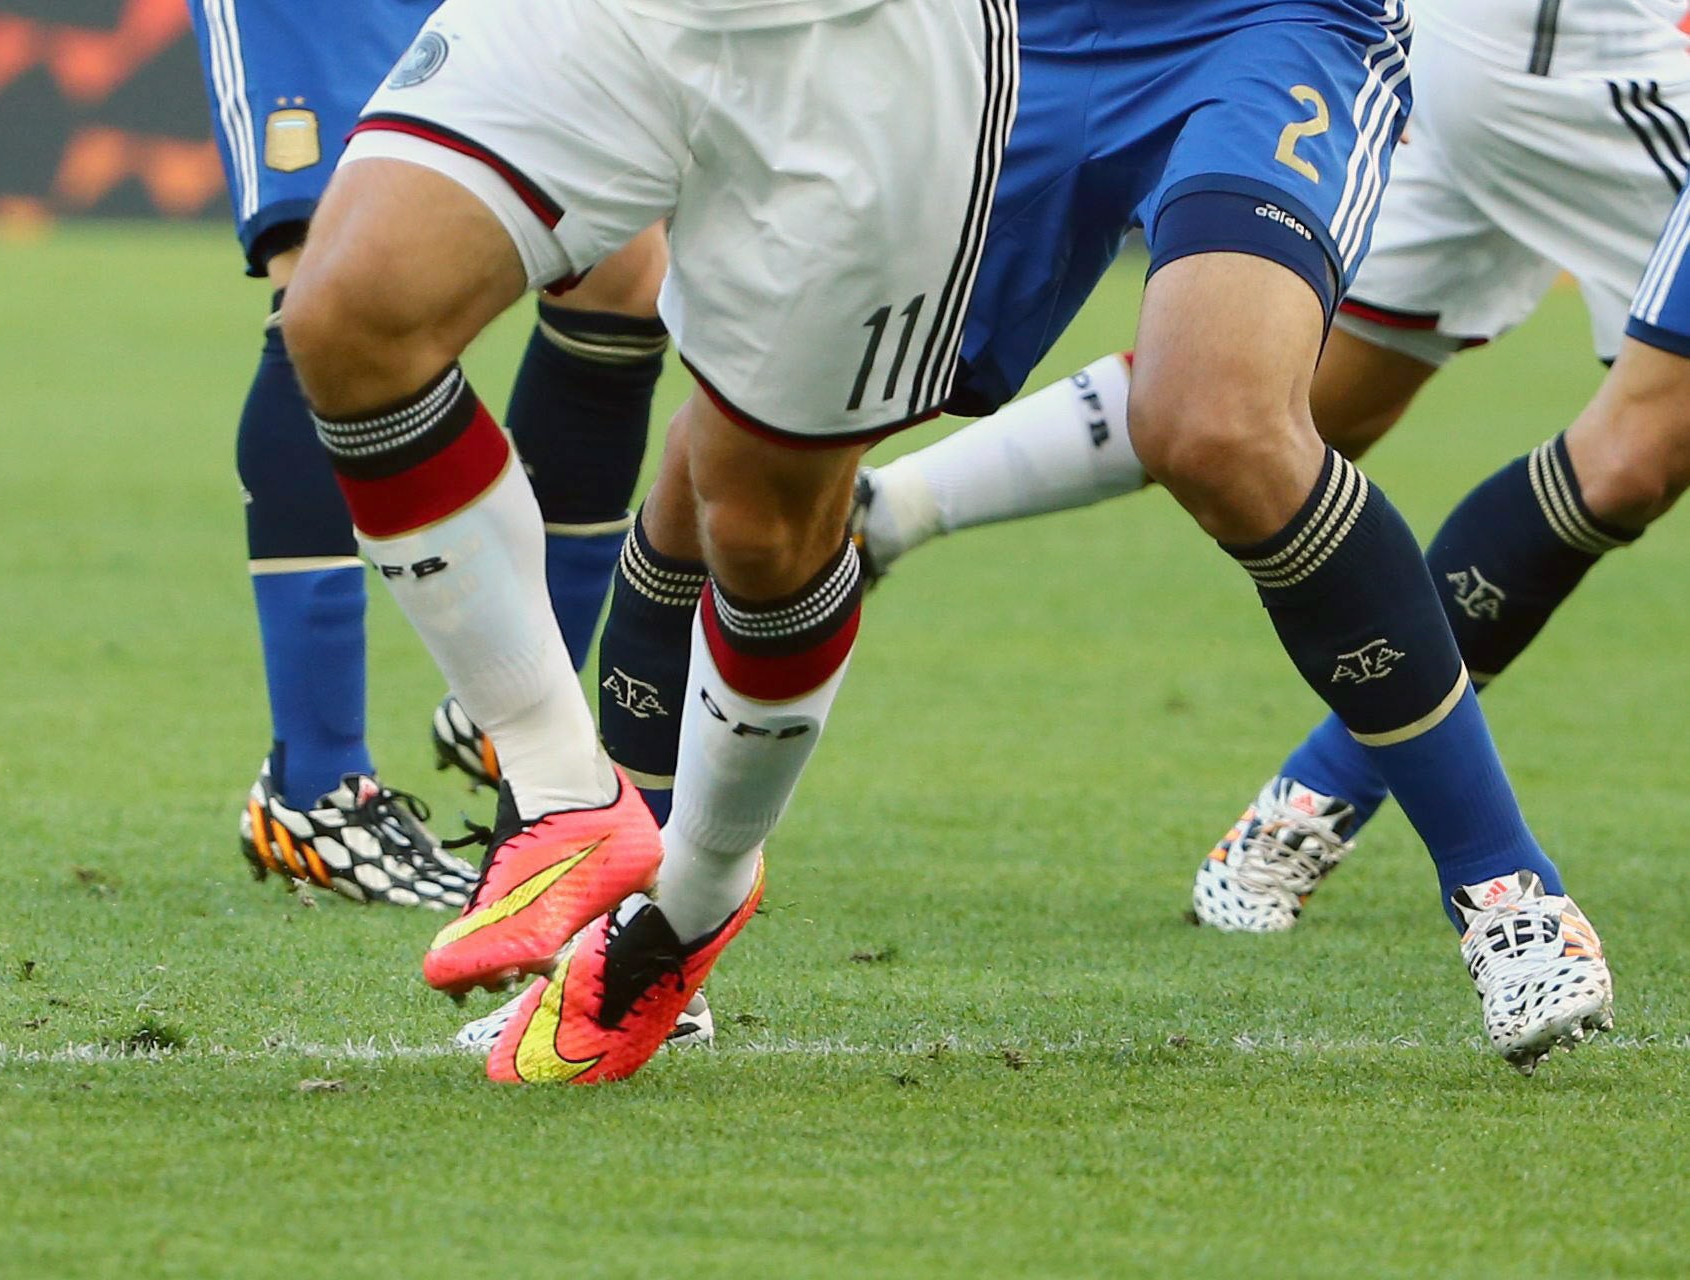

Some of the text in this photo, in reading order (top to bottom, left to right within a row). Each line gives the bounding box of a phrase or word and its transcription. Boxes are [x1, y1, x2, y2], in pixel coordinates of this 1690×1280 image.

[1273, 84, 1330, 185] 2
[1254, 205, 1313, 241] adidas
[845, 292, 926, 412] 11
[372, 556, 449, 579] FB
[1445, 565, 1507, 619] AFA
[1330, 638, 1407, 685] AFA
[602, 666, 670, 719] AFA
